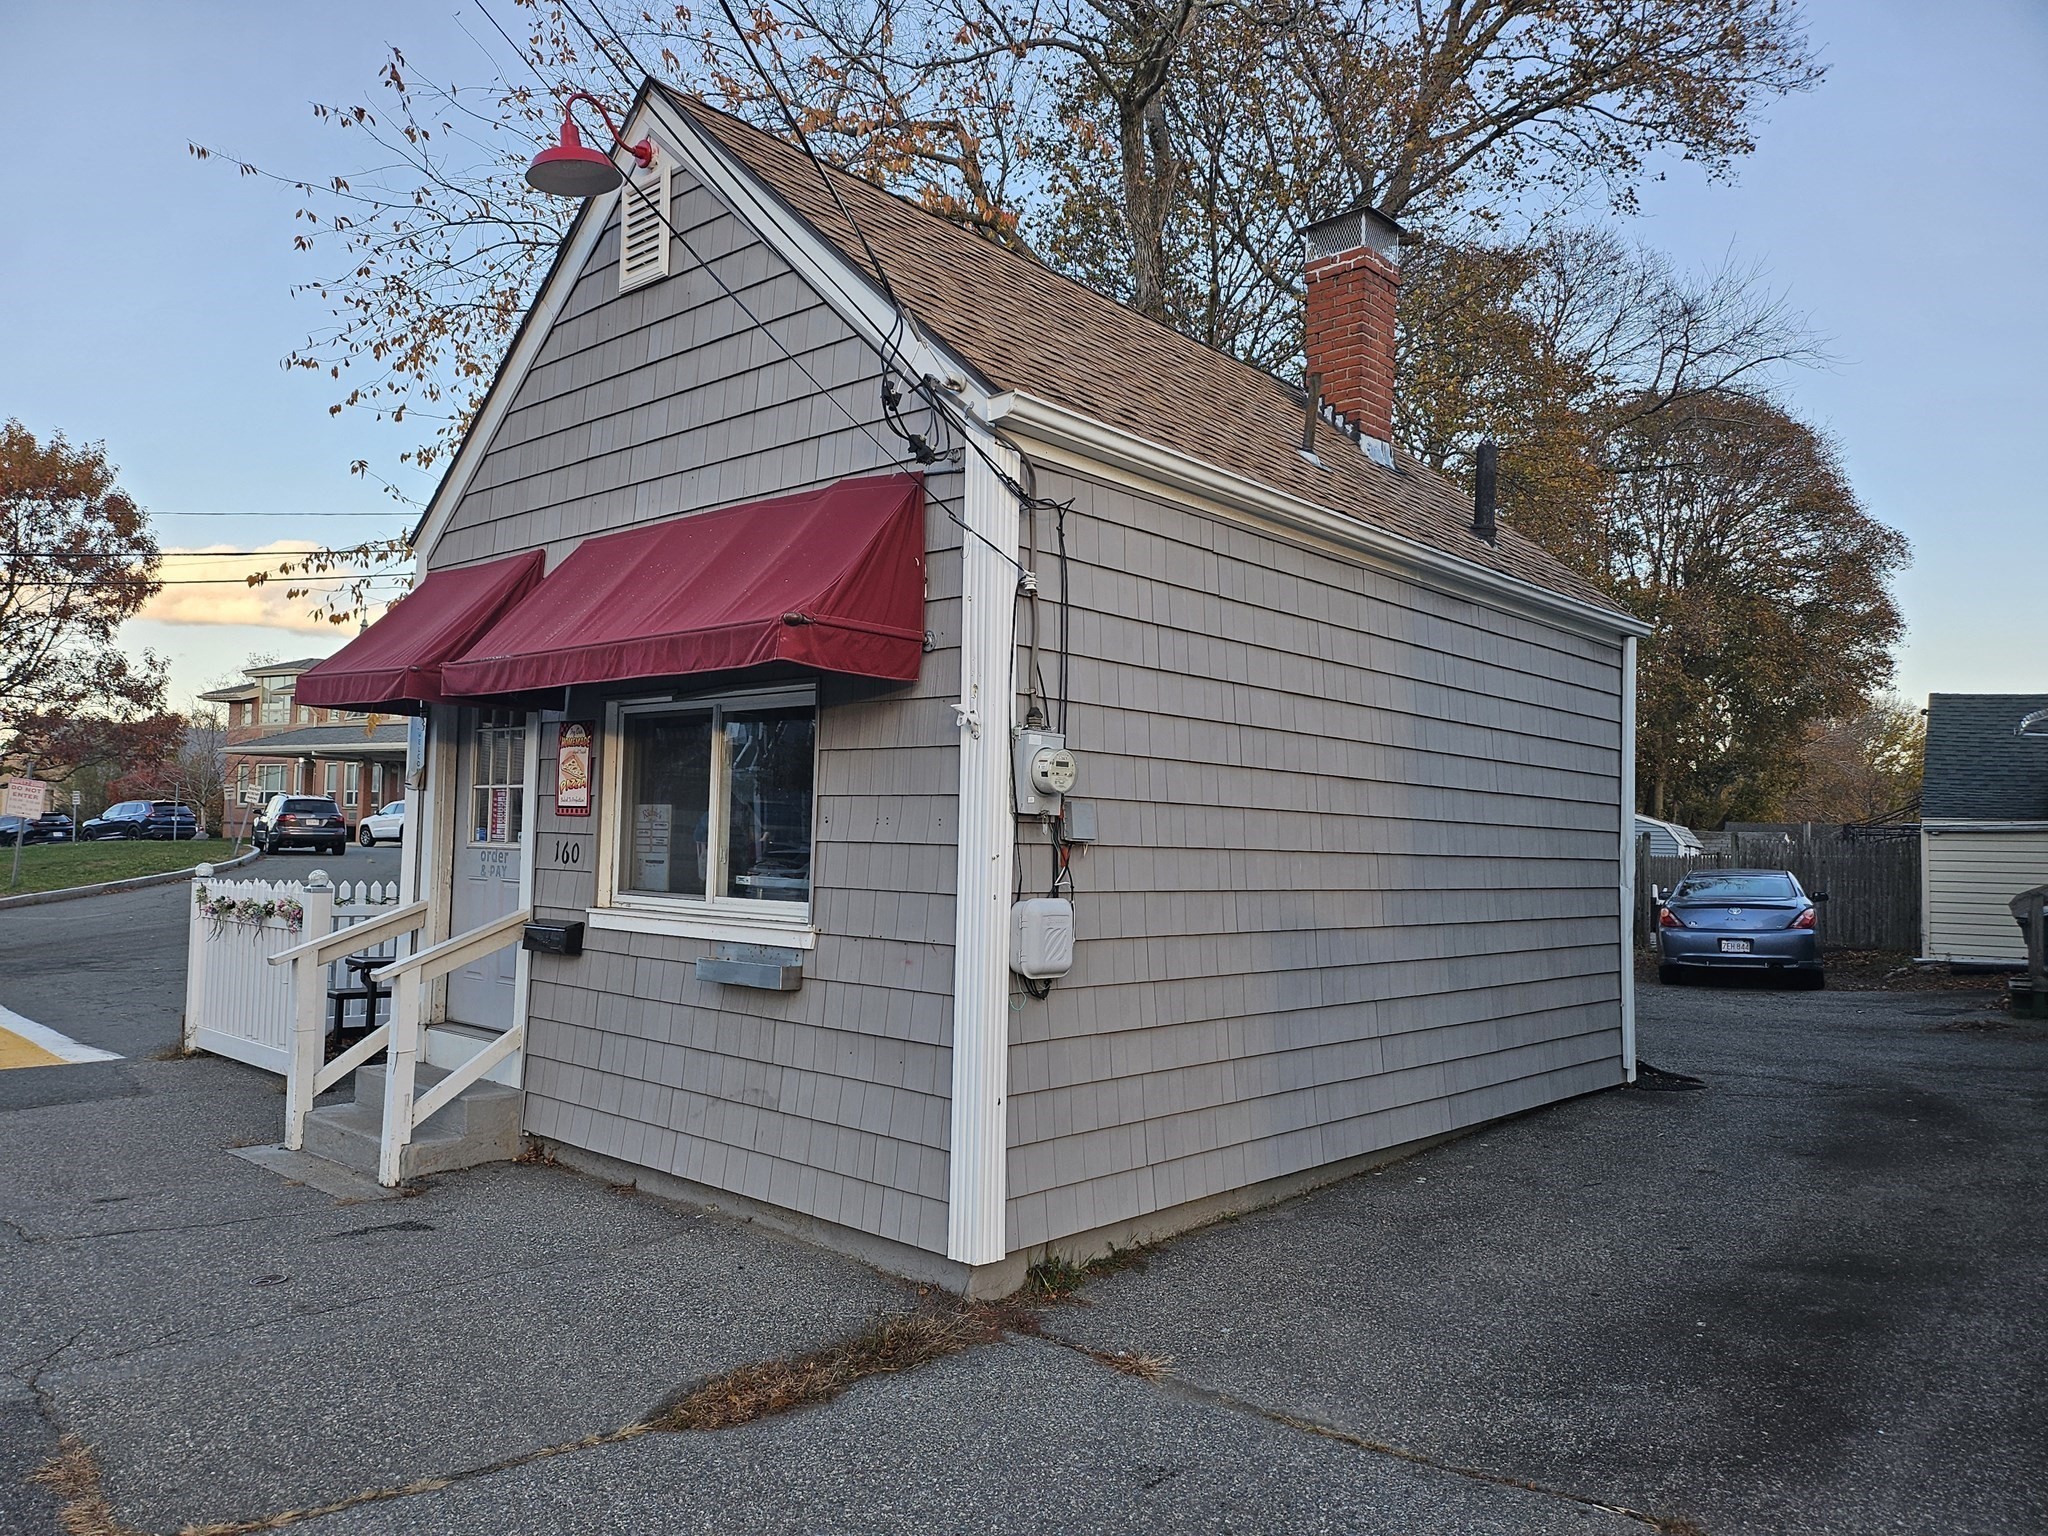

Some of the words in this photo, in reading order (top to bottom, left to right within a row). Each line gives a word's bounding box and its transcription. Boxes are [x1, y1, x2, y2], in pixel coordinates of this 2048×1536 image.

[560, 735, 592, 748] HOMEMADE
[560, 778, 587, 795] PIZZA
[12, 791, 39, 800] ENTER
[480, 849, 509, 864] order
[554, 840, 580, 865] 160
[480, 864, 486, 877] &
[490, 865, 507, 878] PAY
